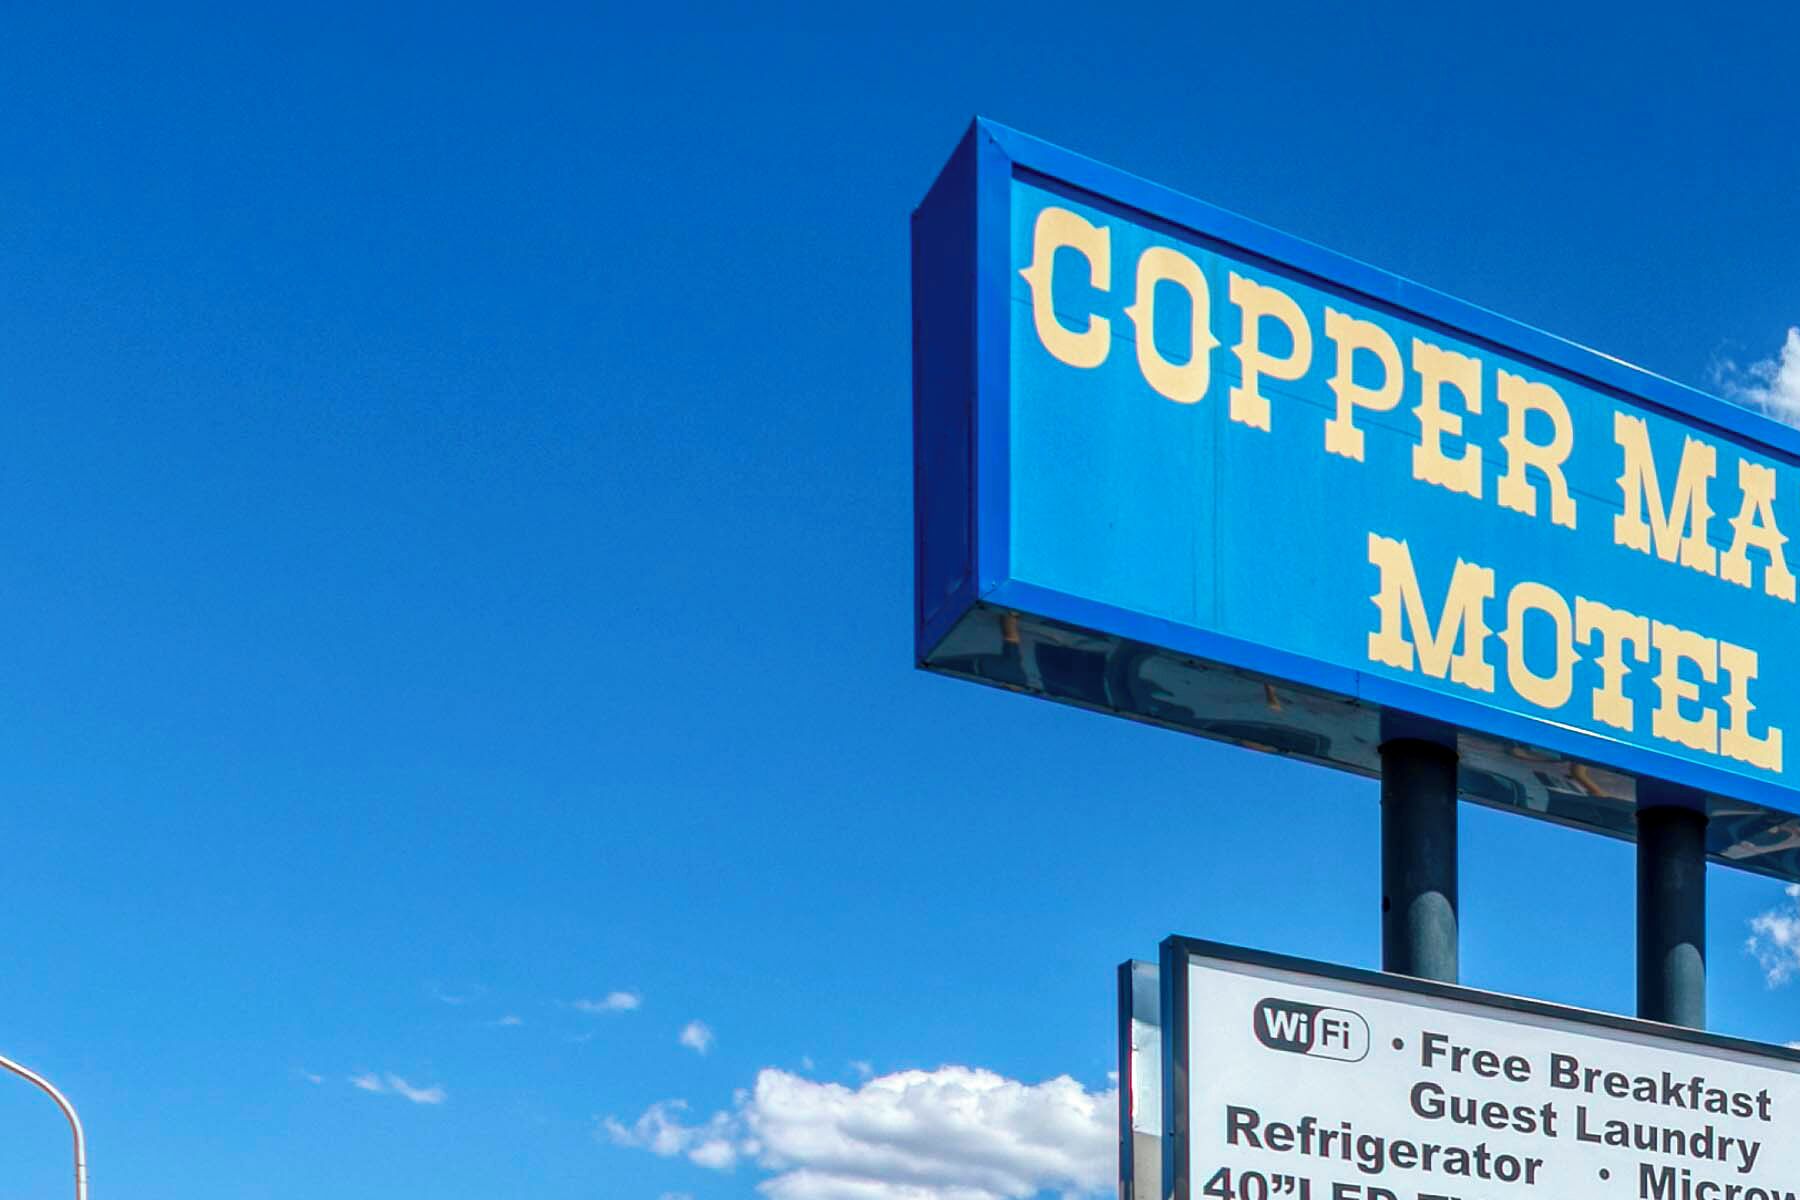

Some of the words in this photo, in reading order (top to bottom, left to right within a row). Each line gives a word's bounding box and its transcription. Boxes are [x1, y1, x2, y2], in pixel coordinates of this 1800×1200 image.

[1022, 209, 1575, 528] COPPER
[1369, 535, 1781, 772] MOTEL
[1421, 1031, 1531, 1082] Free
[1550, 1052, 1772, 1122] Breakfast
[1226, 1106, 1544, 1185] Refrigerator
[1410, 1081, 1557, 1138] Guest
[1576, 1106, 1761, 1174] Laundry
